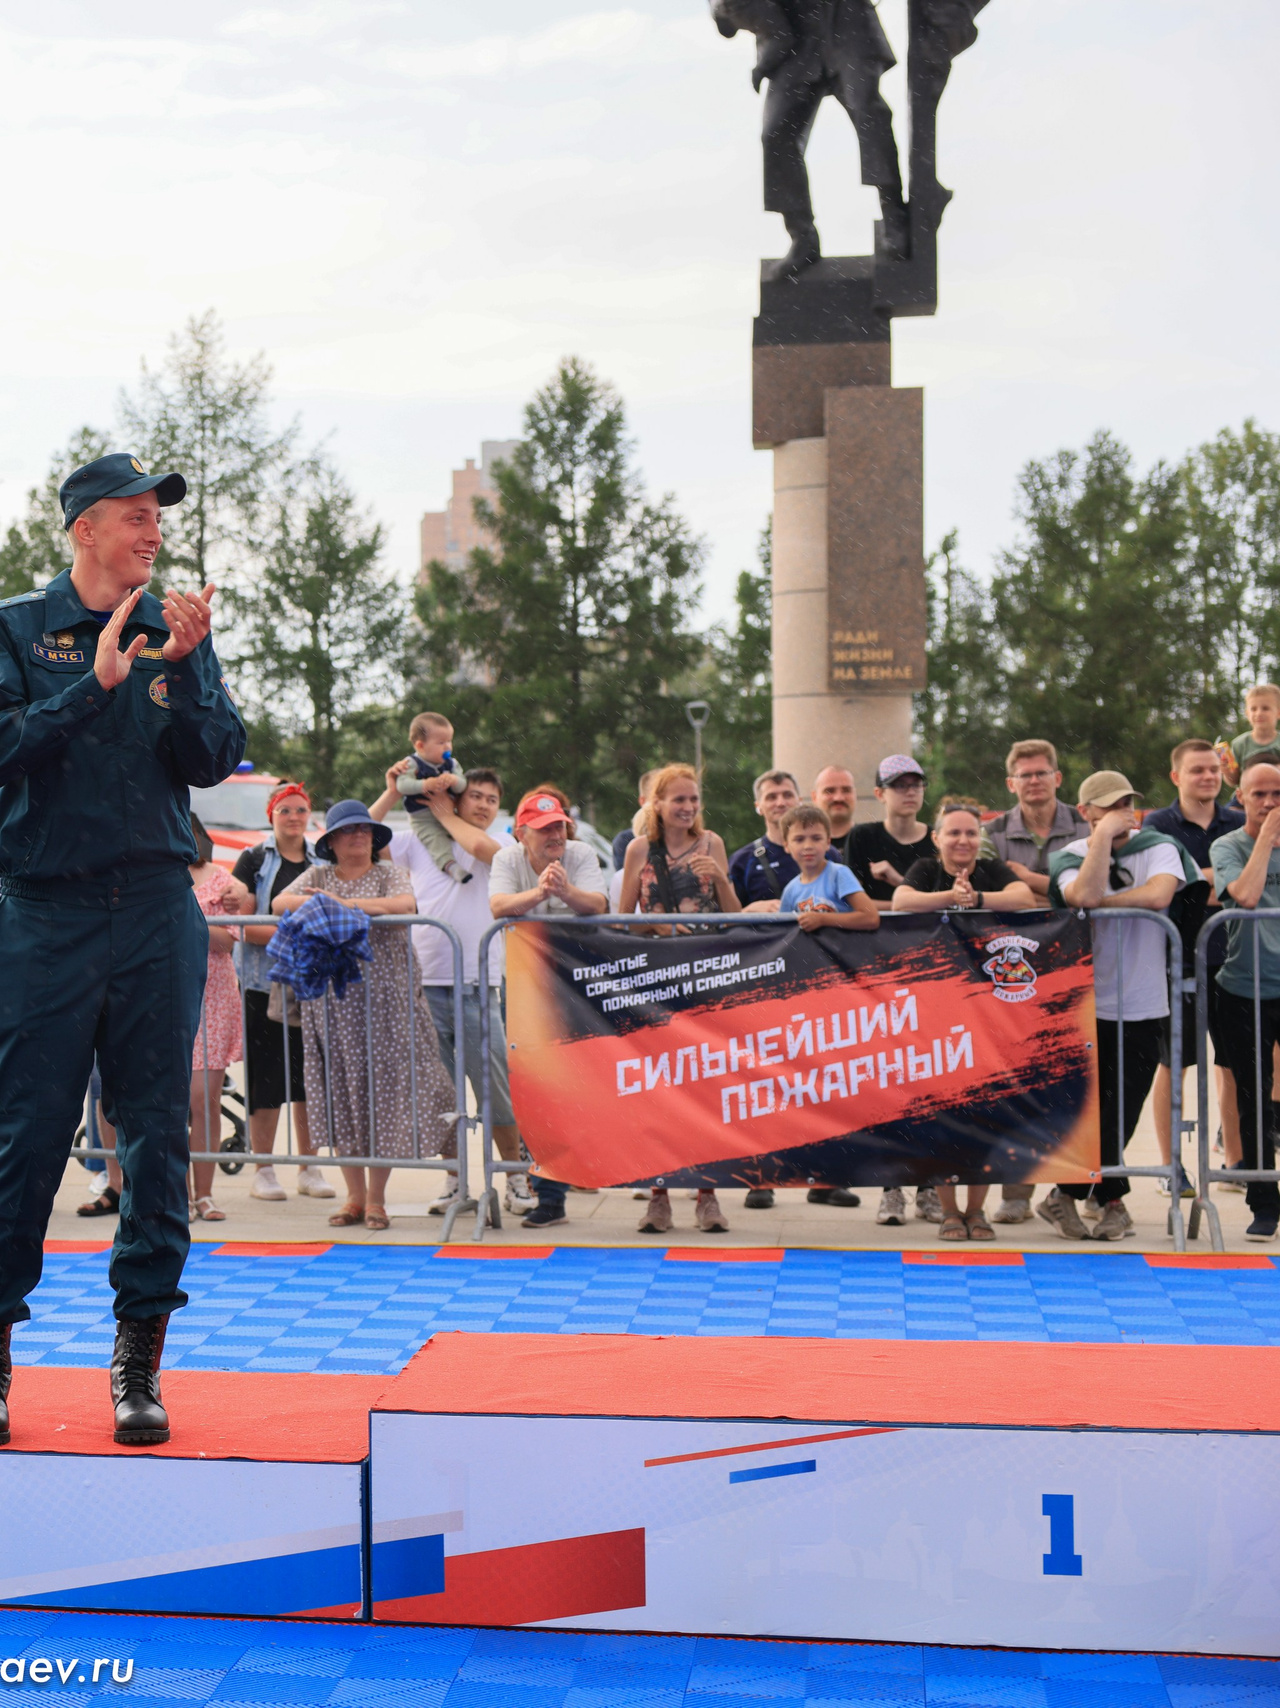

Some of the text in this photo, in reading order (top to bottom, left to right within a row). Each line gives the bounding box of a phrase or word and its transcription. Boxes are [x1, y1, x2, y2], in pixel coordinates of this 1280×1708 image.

[833, 630, 879, 643] РАДИ
[833, 648, 894, 661] ЖИЗНИ
[47, 651, 78, 661] МЧС
[833, 665, 913, 680] НА ЗЕМЛЕ
[573, 953, 648, 981] ОТКРЫТЫЕ
[586, 952, 740, 997] СОРЕВНОВАНИЯ СРЕДИ
[602, 957, 786, 1012] ПОЖАРНЫХ И СПАСАТЕЛЕЙ
[616, 988, 918, 1097] СИЛЬНЕЙШИЙ
[721, 1025, 974, 1125] ПОЖАРНЫЙ
[1042, 1494, 1083, 1576] 1
